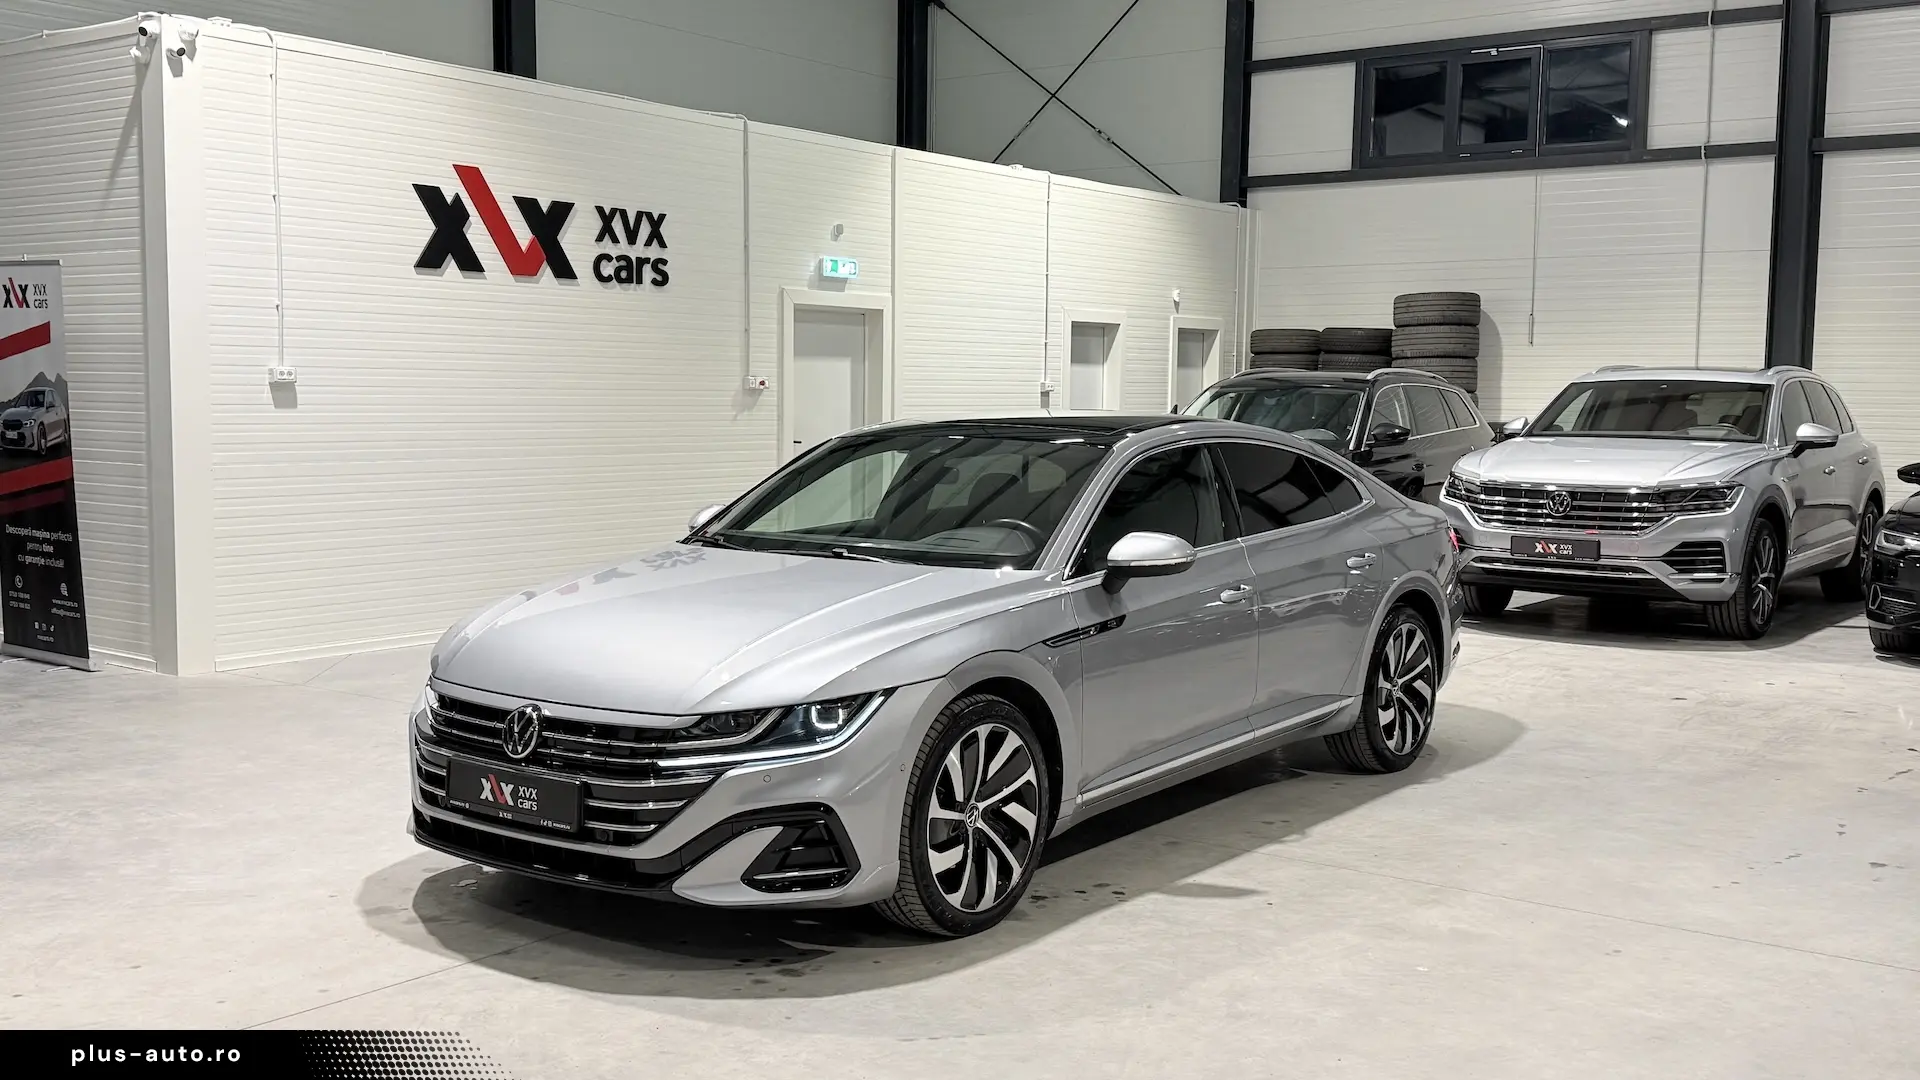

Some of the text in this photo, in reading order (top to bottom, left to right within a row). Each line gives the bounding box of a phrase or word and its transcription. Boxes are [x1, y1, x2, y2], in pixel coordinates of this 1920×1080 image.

[595, 205, 668, 248] XVX
[593, 253, 670, 287] cars
[32, 284, 47, 296] XVX
[33, 298, 48, 309] cars
[518, 786, 537, 800] XVX
[517, 798, 537, 811] cars
